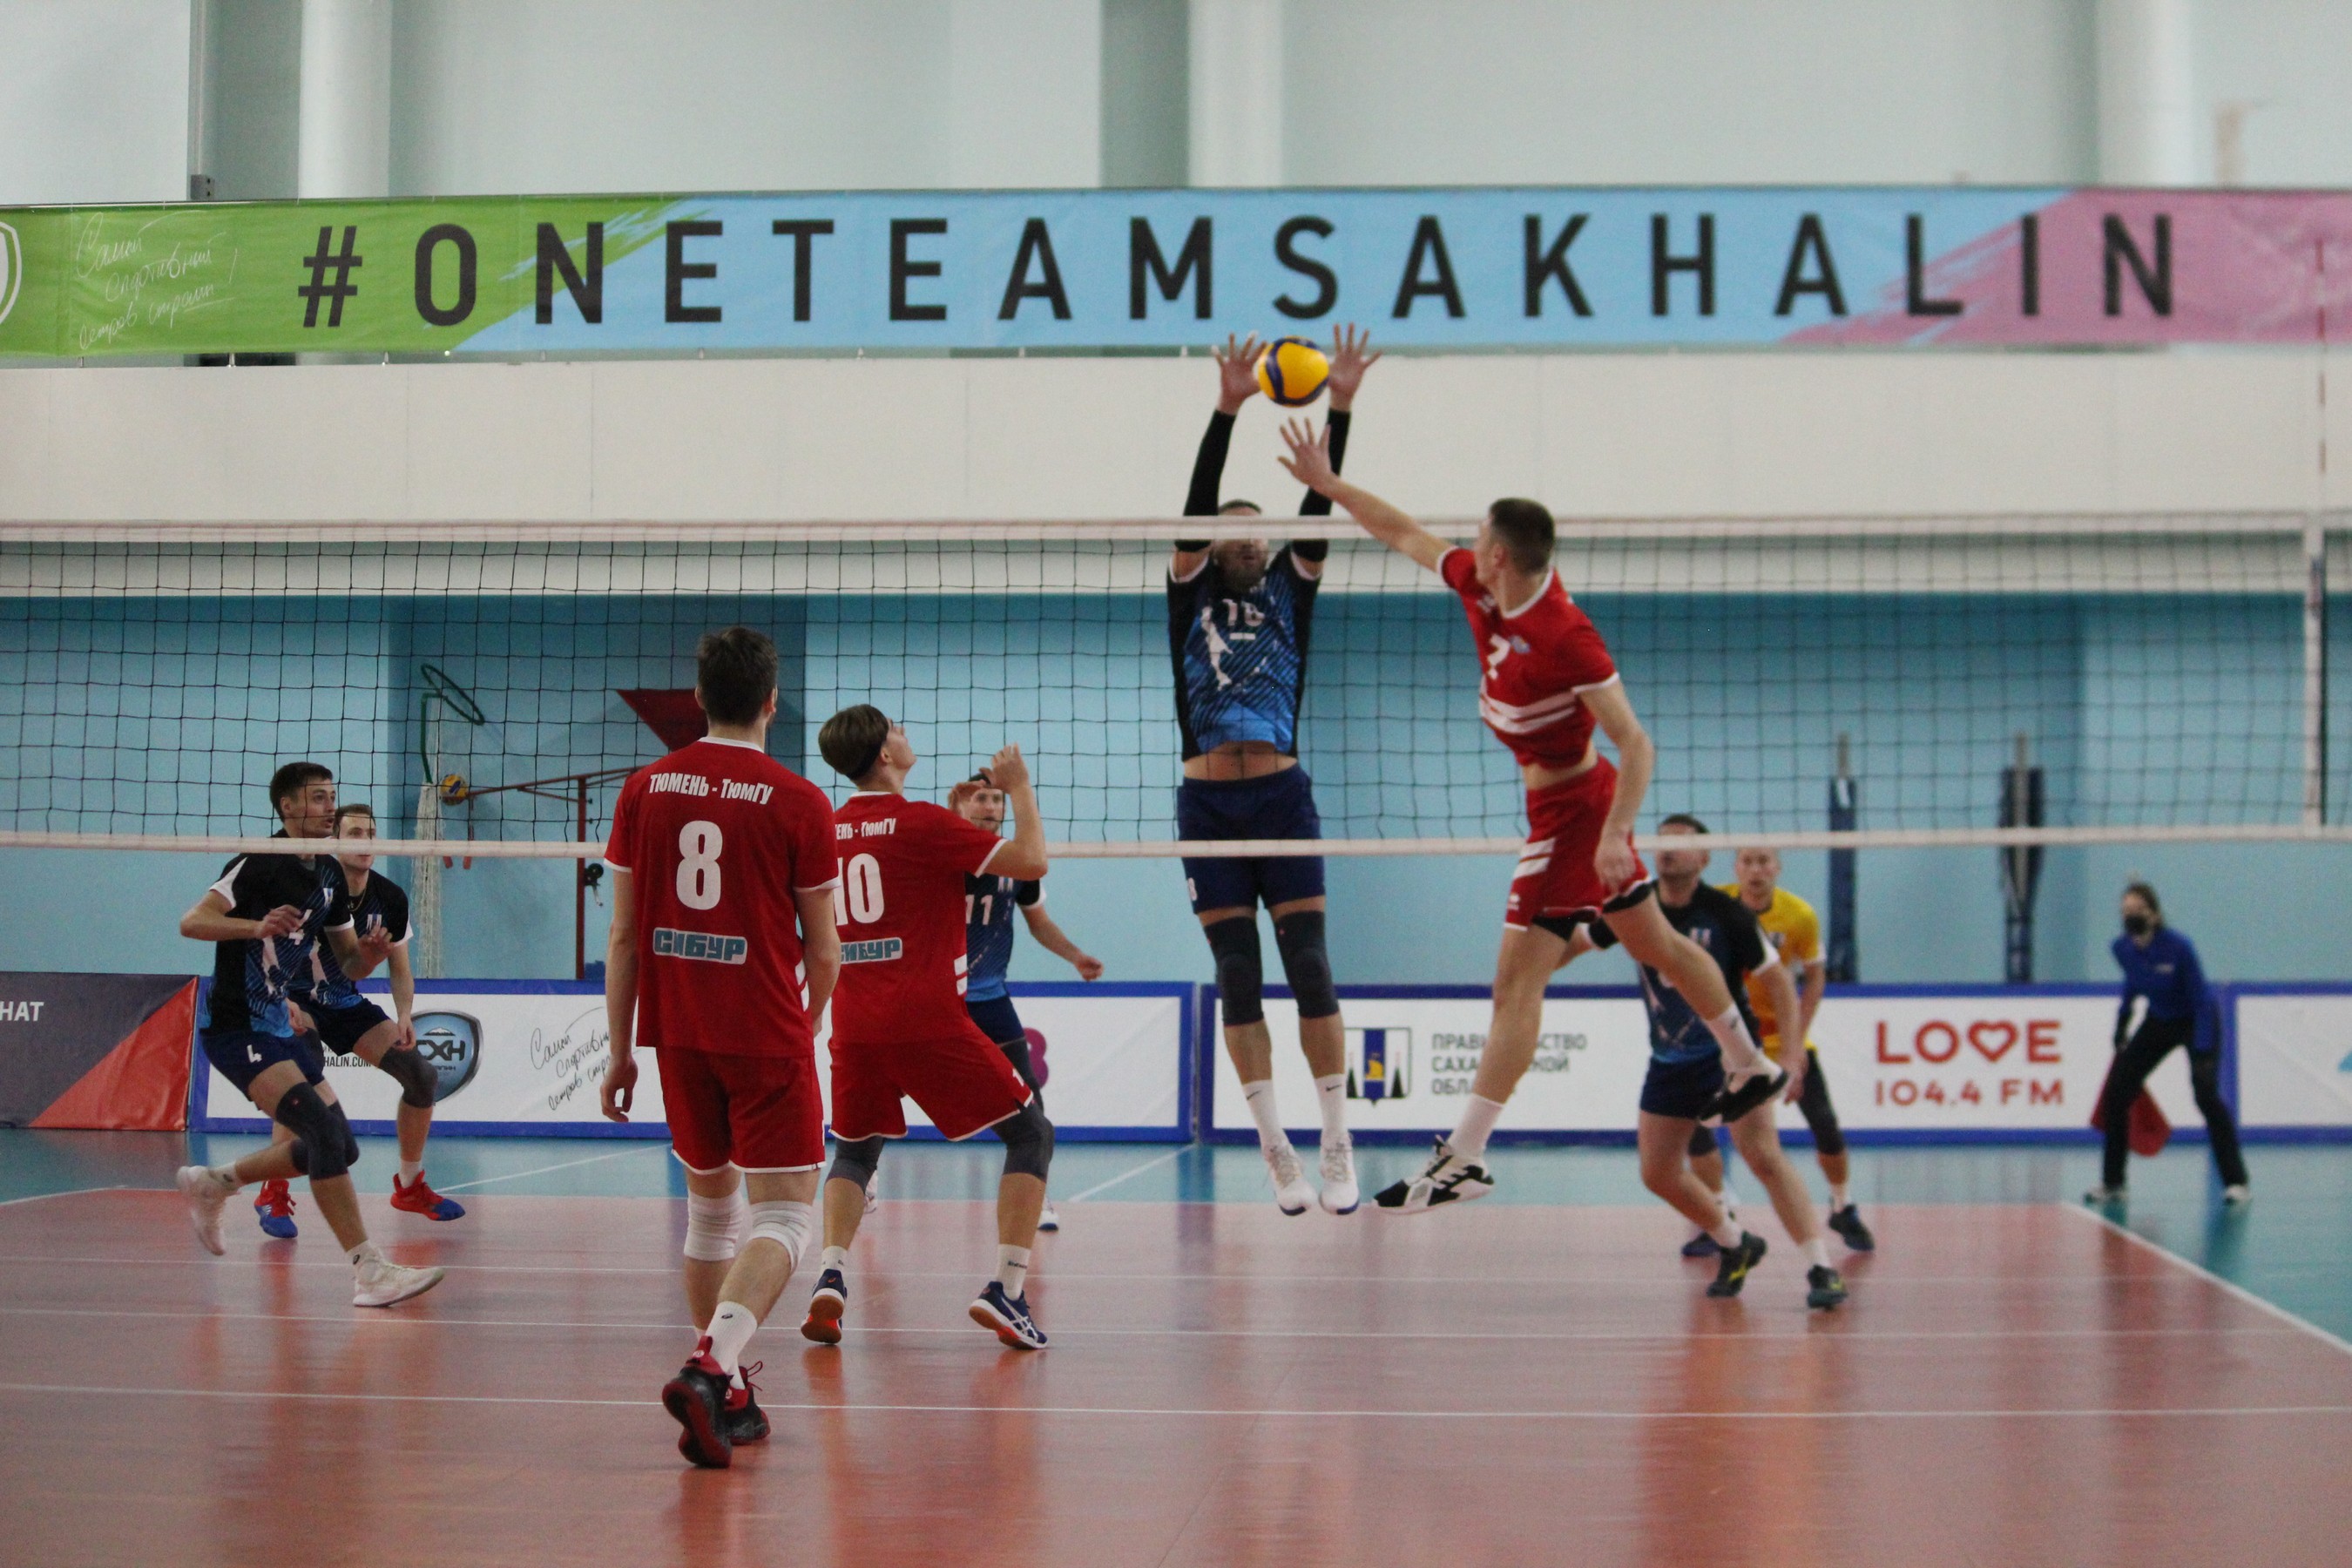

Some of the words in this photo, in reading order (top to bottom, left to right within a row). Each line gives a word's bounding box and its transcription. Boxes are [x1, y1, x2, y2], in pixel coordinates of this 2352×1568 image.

[298, 214, 2173, 328] #ONETEAMSAKHALIN
[649, 773, 709, 796] ТЮМЕНЬ
[676, 820, 723, 910] 8
[834, 853, 885, 926] 10
[965, 894, 993, 925] 11
[841, 938, 902, 963] ИБУР
[2001, 1079, 2064, 1105] FM
